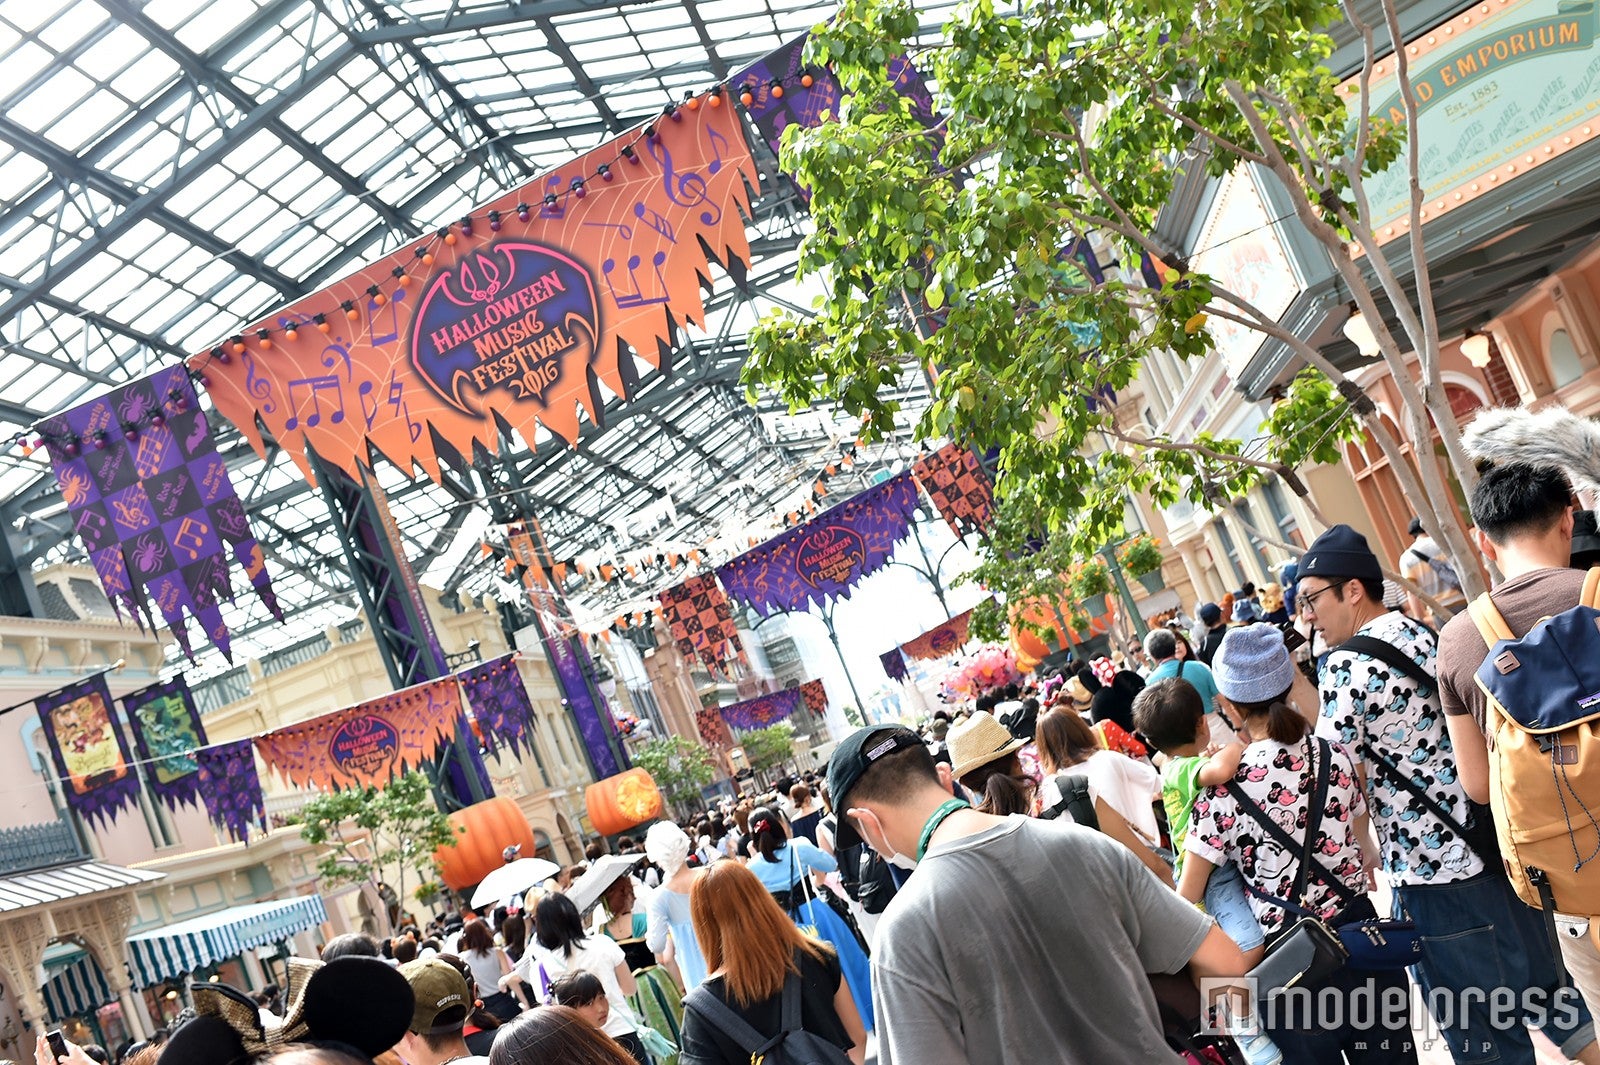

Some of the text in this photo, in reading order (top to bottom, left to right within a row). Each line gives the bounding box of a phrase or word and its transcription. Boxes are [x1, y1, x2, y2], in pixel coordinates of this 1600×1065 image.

[1439, 21, 1580, 88] EMPORIUM
[1444, 80, 1499, 117] Est. 1883
[1530, 75, 1567, 124] TINWARE
[1488, 101, 1521, 146] APPAREL
[430, 269, 566, 356] HALLOWEEN
[472, 308, 545, 363] MUSIC
[470, 324, 575, 392] FESTIVAL
[508, 359, 560, 400] 2016
[98, 455, 113, 479] Rock
[203, 462, 217, 487] Rock
[156, 481, 173, 503] Rock
[803, 535, 852, 567] HALLOWEEN
[819, 550, 846, 570] MUSIC
[818, 556, 856, 581] FESTIVAL
[411, 588, 434, 638] FESTIVAL
[338, 729, 388, 752] HALLOWEEN
[352, 741, 379, 758] MUSIC
[350, 748, 388, 768] FESTIVAL
